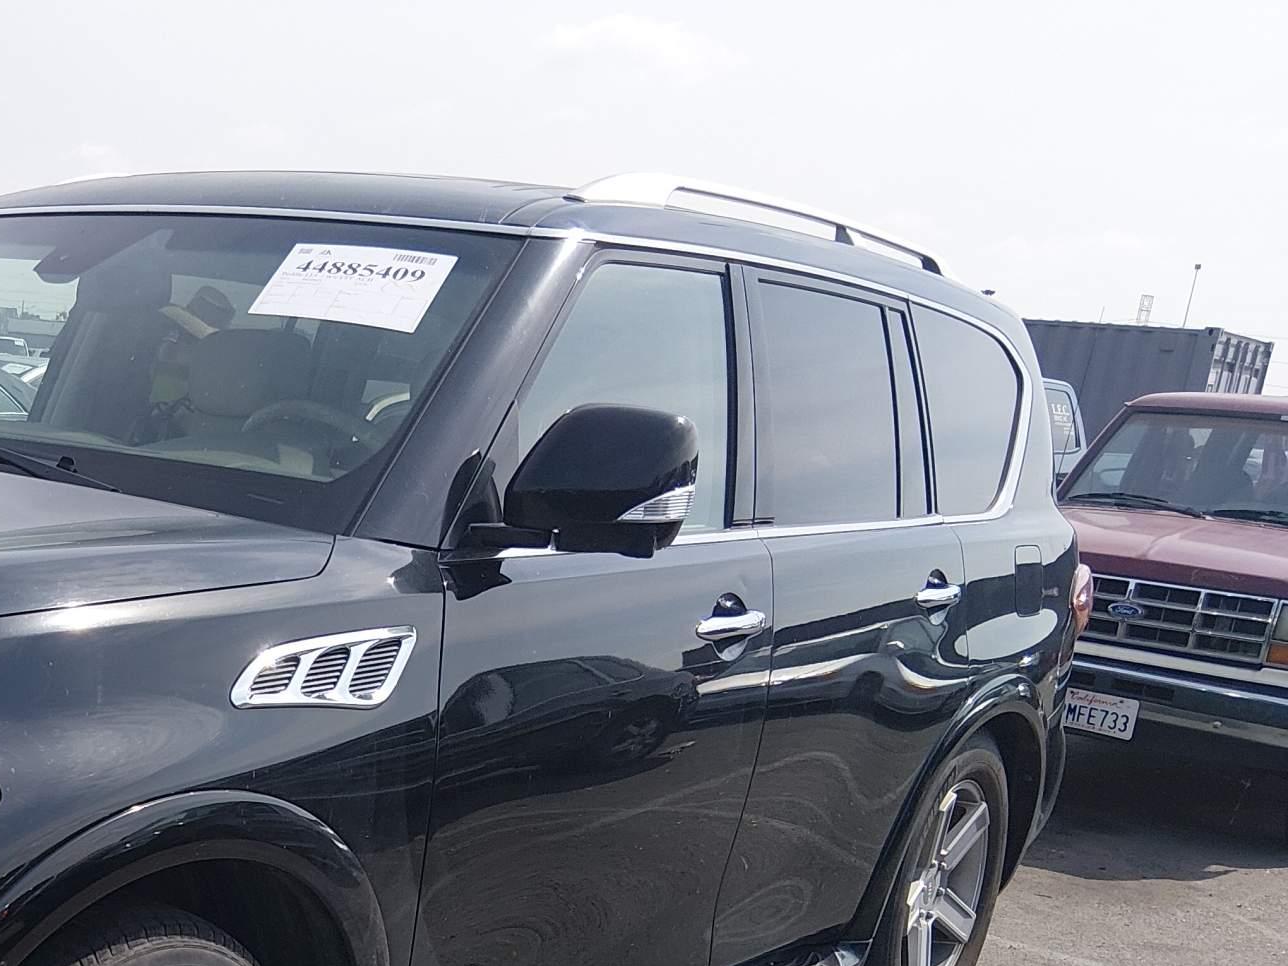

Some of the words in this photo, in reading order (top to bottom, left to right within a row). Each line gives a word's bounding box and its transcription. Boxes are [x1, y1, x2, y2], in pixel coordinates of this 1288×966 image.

[296, 260, 426, 282] 44885409
[1070, 690, 1118, 706] California
[1064, 703, 1130, 733] MFE733
